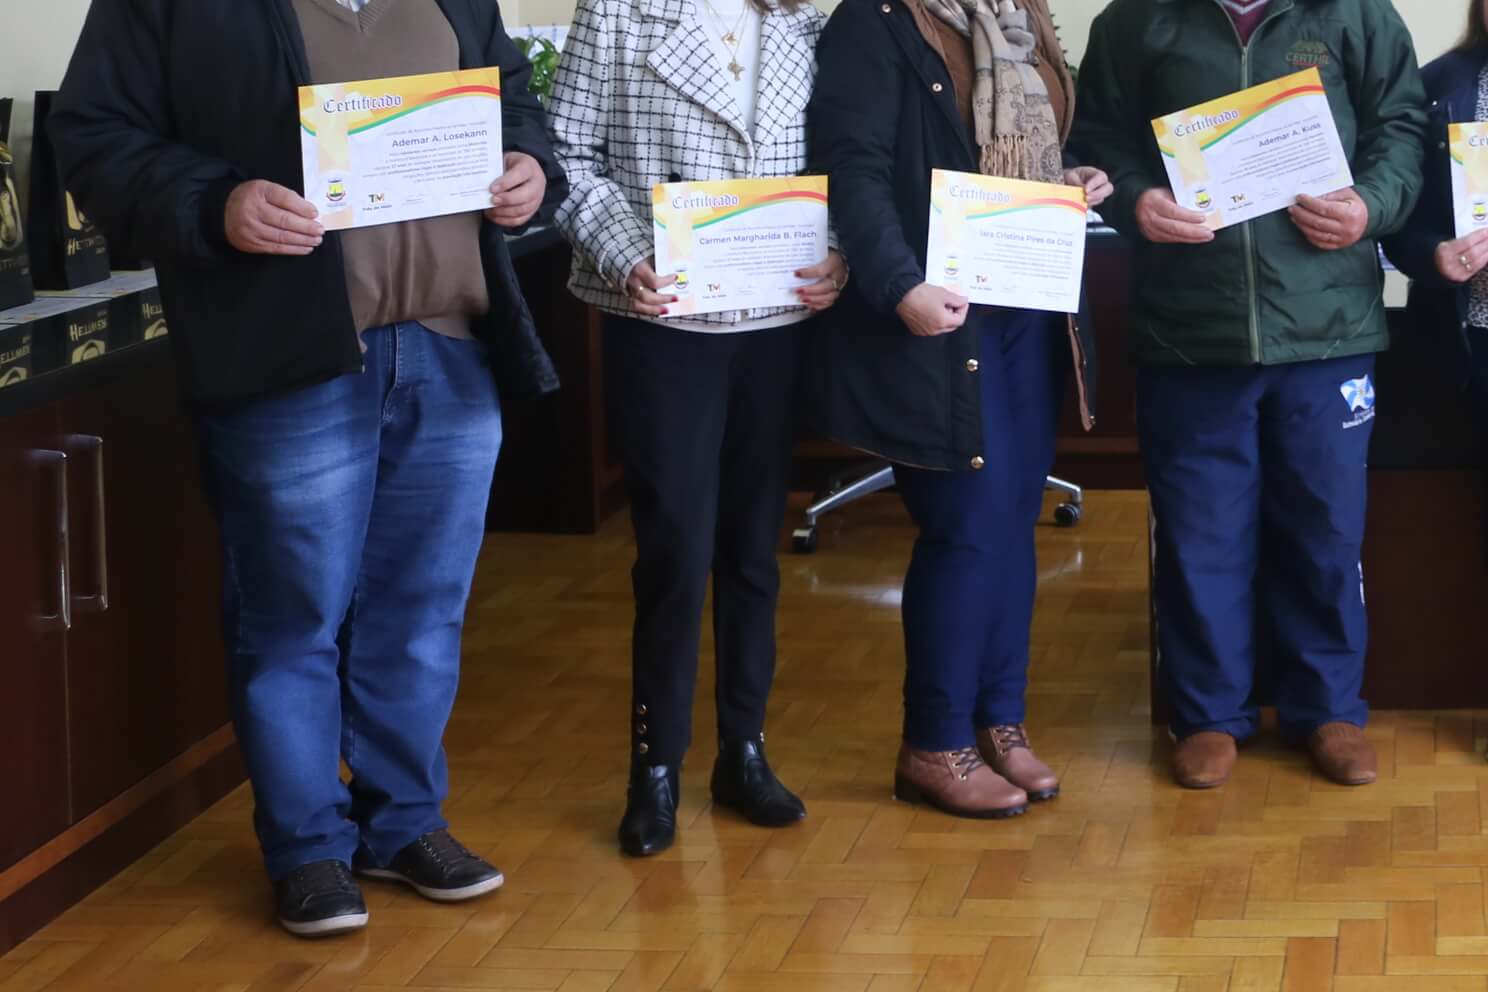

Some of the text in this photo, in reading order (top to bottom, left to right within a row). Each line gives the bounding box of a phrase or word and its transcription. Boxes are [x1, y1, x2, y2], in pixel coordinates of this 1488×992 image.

[323, 95, 402, 114] Certificado
[1174, 109, 1239, 137] Certificado
[392, 129, 488, 148] Ademar A. Losekann
[1258, 133, 1290, 147] Ademar
[672, 194, 739, 209] Certificado
[950, 185, 1010, 203] Certificado
[699, 236, 731, 246] Carmen
